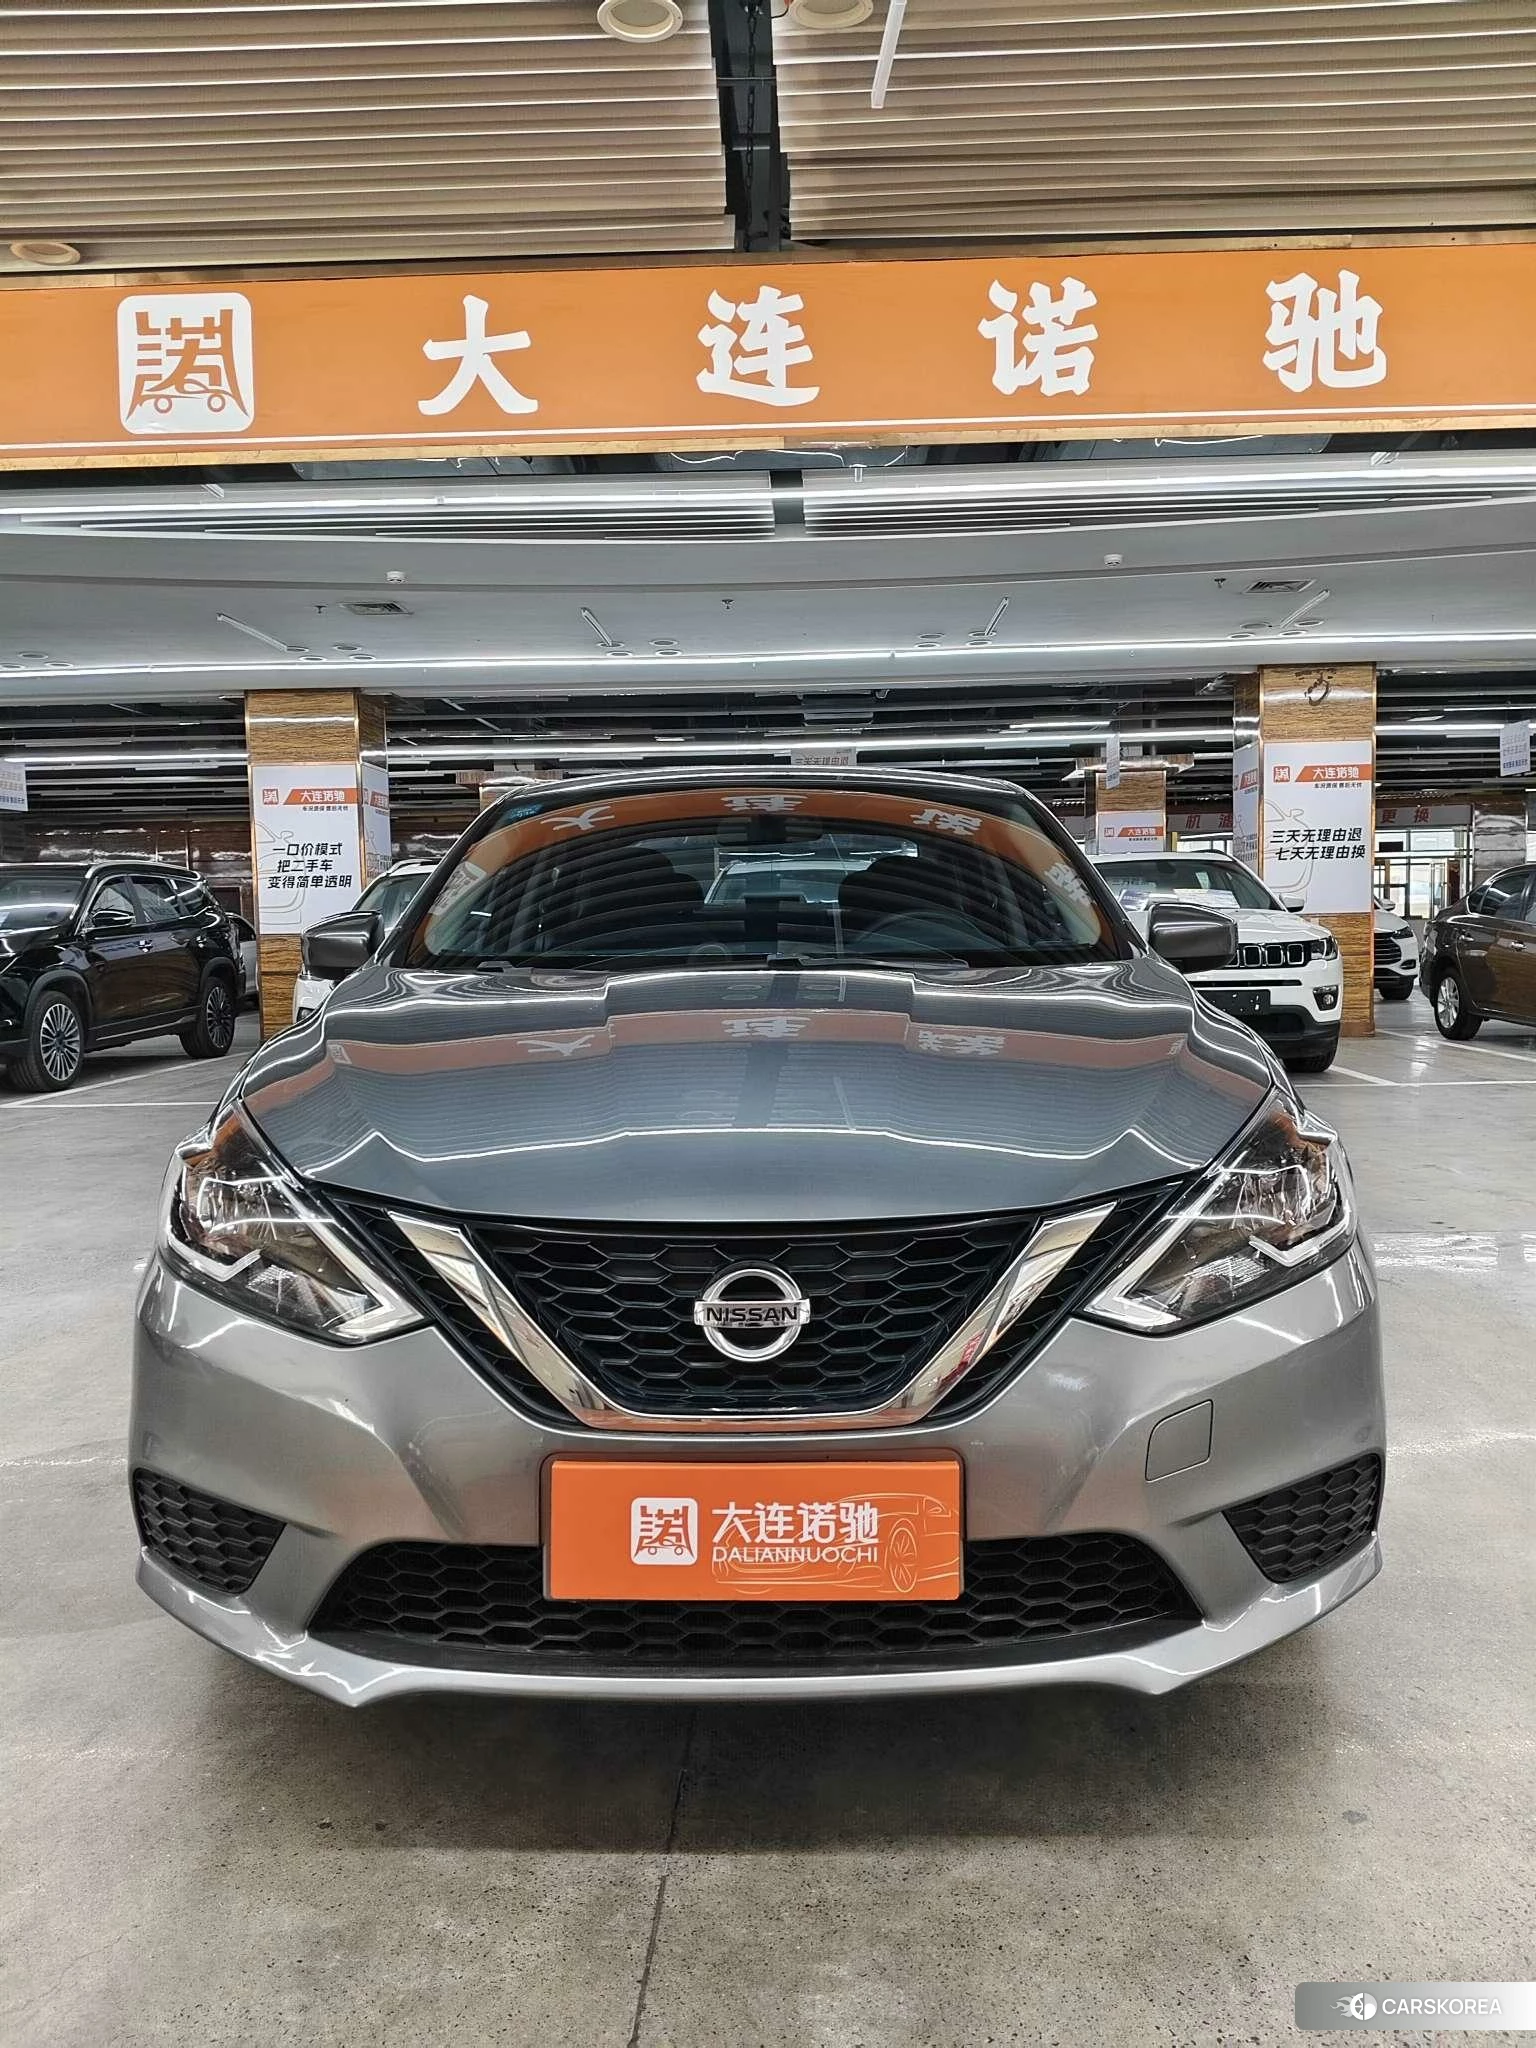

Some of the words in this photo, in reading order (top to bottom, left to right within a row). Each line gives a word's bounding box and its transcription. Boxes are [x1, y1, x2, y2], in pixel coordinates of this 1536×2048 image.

[416, 268, 1388, 417] 大连诺驰
[1312, 766, 1360, 779] 大连诺驰
[300, 789, 345, 802] 大连诺驰
[1270, 827, 1362, 843] 三天无理由退
[273, 842, 343, 856] 一口价模式
[1275, 844, 1366, 860] 七天无理由换
[277, 859, 333, 873] 把二手车
[268, 875, 352, 889] 变得简单透明
[706, 1306, 798, 1322] NISSAN
[711, 1501, 879, 1543] 大连诺驰
[713, 1546, 878, 1563] DALIANNUOCHI
